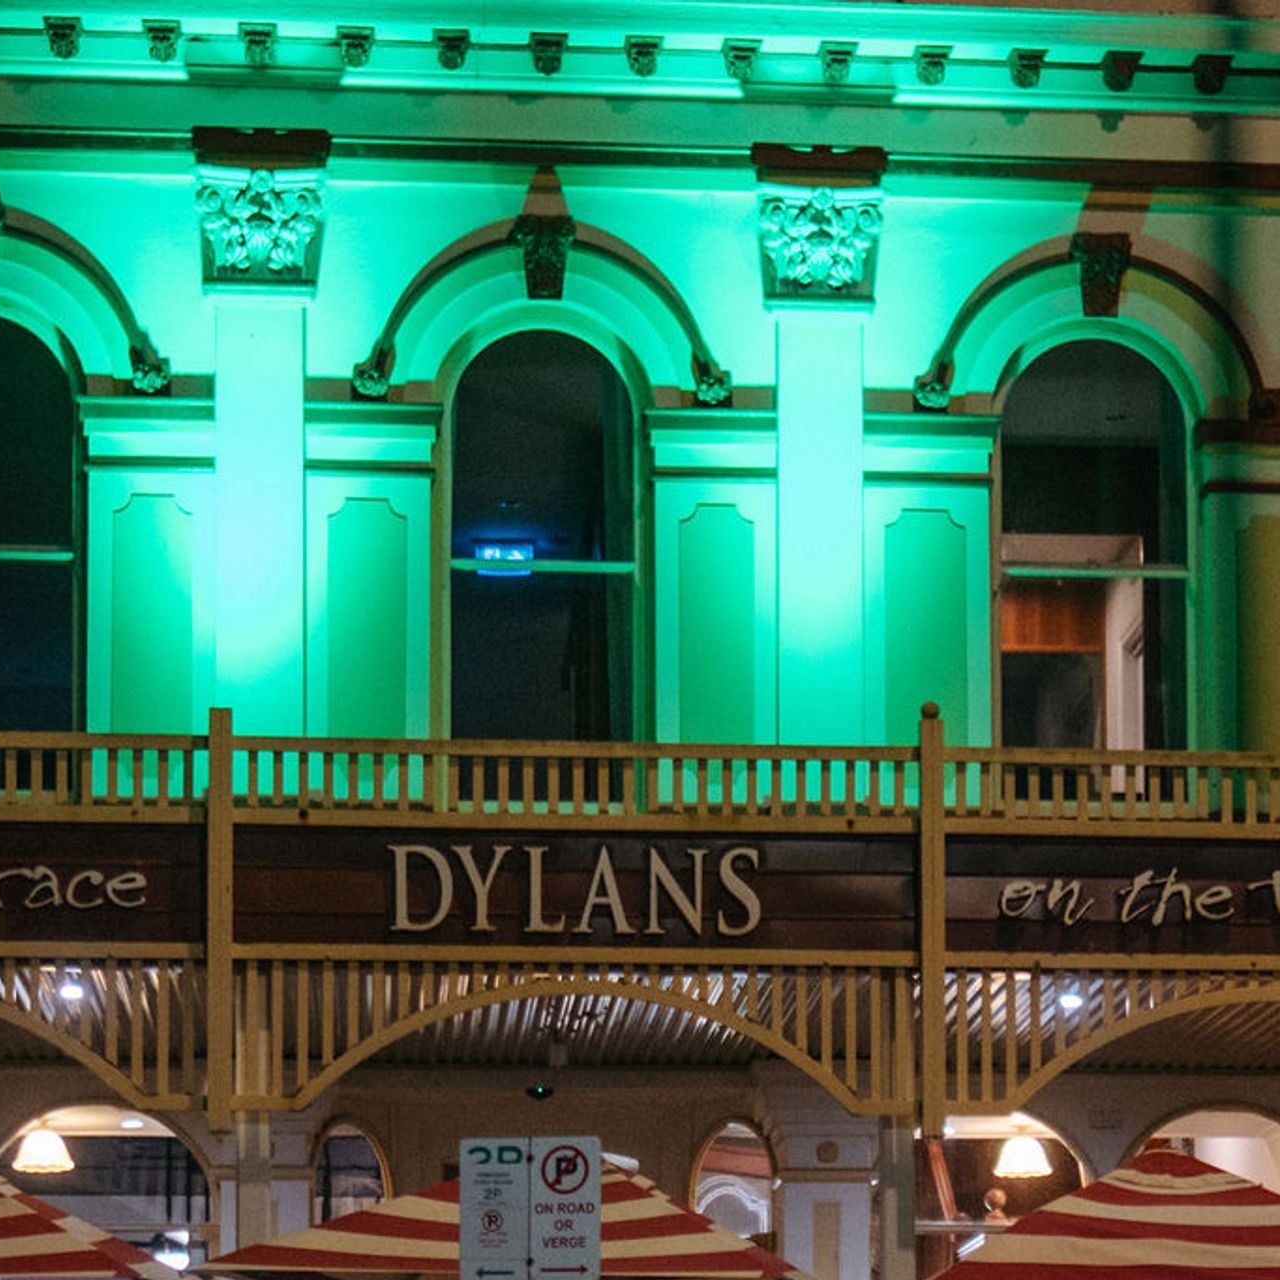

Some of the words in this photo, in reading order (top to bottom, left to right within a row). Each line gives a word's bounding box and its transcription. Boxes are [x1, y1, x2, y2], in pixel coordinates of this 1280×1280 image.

[387, 844, 762, 938] DYLANS
[999, 878, 1096, 926] on
[1118, 867, 1237, 927] the
[535, 1202, 553, 1214] ON
[557, 1202, 595, 1214] ROAD
[553, 1219, 573, 1231] OR
[542, 1236, 587, 1248] VERGE
